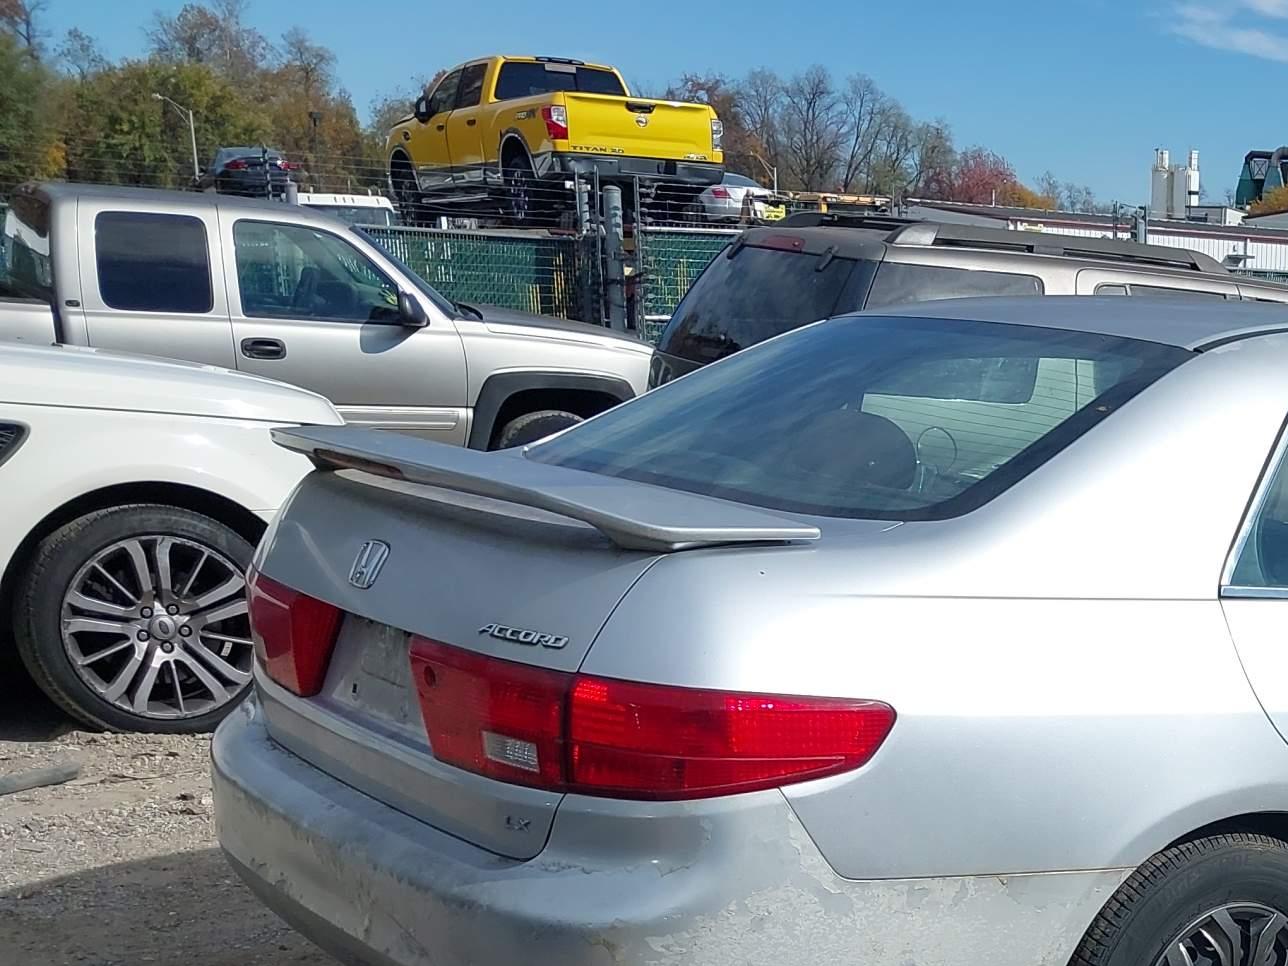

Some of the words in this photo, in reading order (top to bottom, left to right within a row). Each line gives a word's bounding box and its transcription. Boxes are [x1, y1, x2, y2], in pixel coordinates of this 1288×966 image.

[570, 144, 608, 153] TITAN
[478, 623, 569, 649] ACCORD
[504, 815, 531, 832] LX
